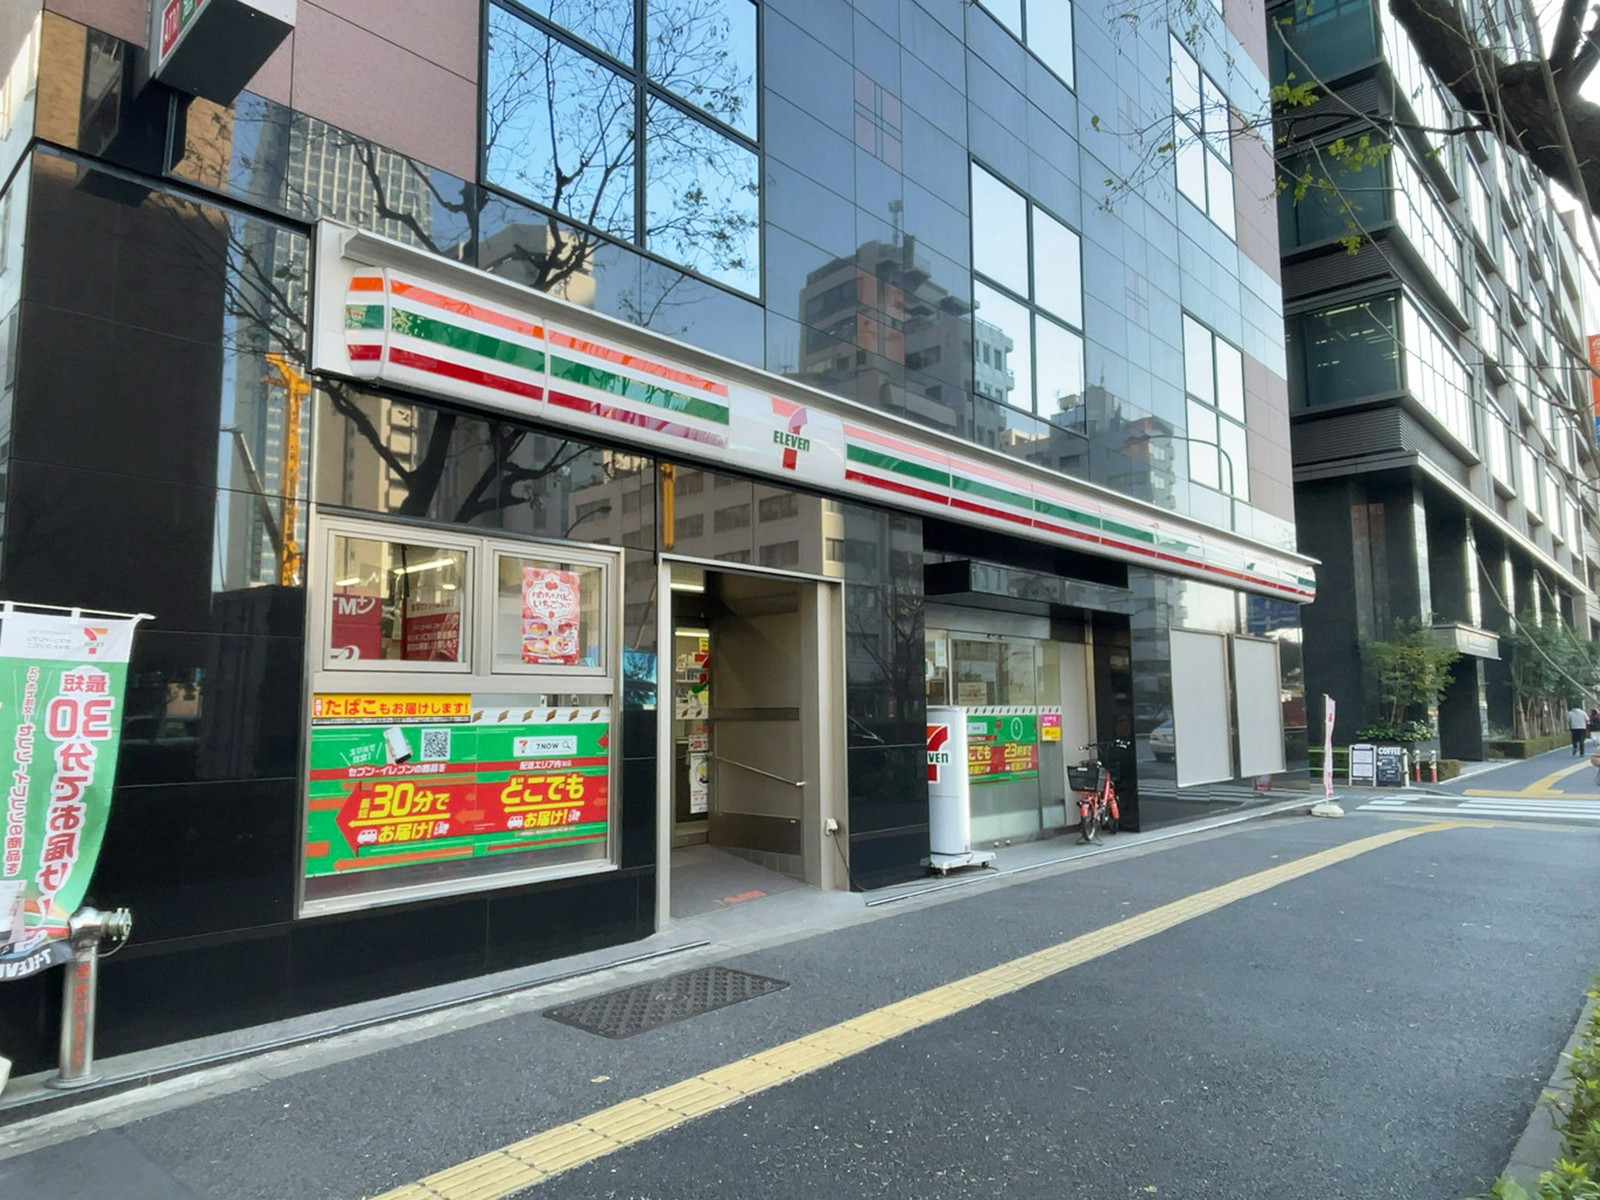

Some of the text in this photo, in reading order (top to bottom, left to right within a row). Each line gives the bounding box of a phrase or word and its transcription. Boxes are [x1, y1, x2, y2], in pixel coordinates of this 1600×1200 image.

[325, 699, 469, 715] たばこもお届けします!
[536, 742, 560, 750] 7NOW
[969, 745, 991, 760] こでも
[501, 774, 585, 804] どこでも
[369, 783, 451, 818] 30分で
[524, 809, 569, 828] お届け!
[378, 821, 434, 843] お届け!
